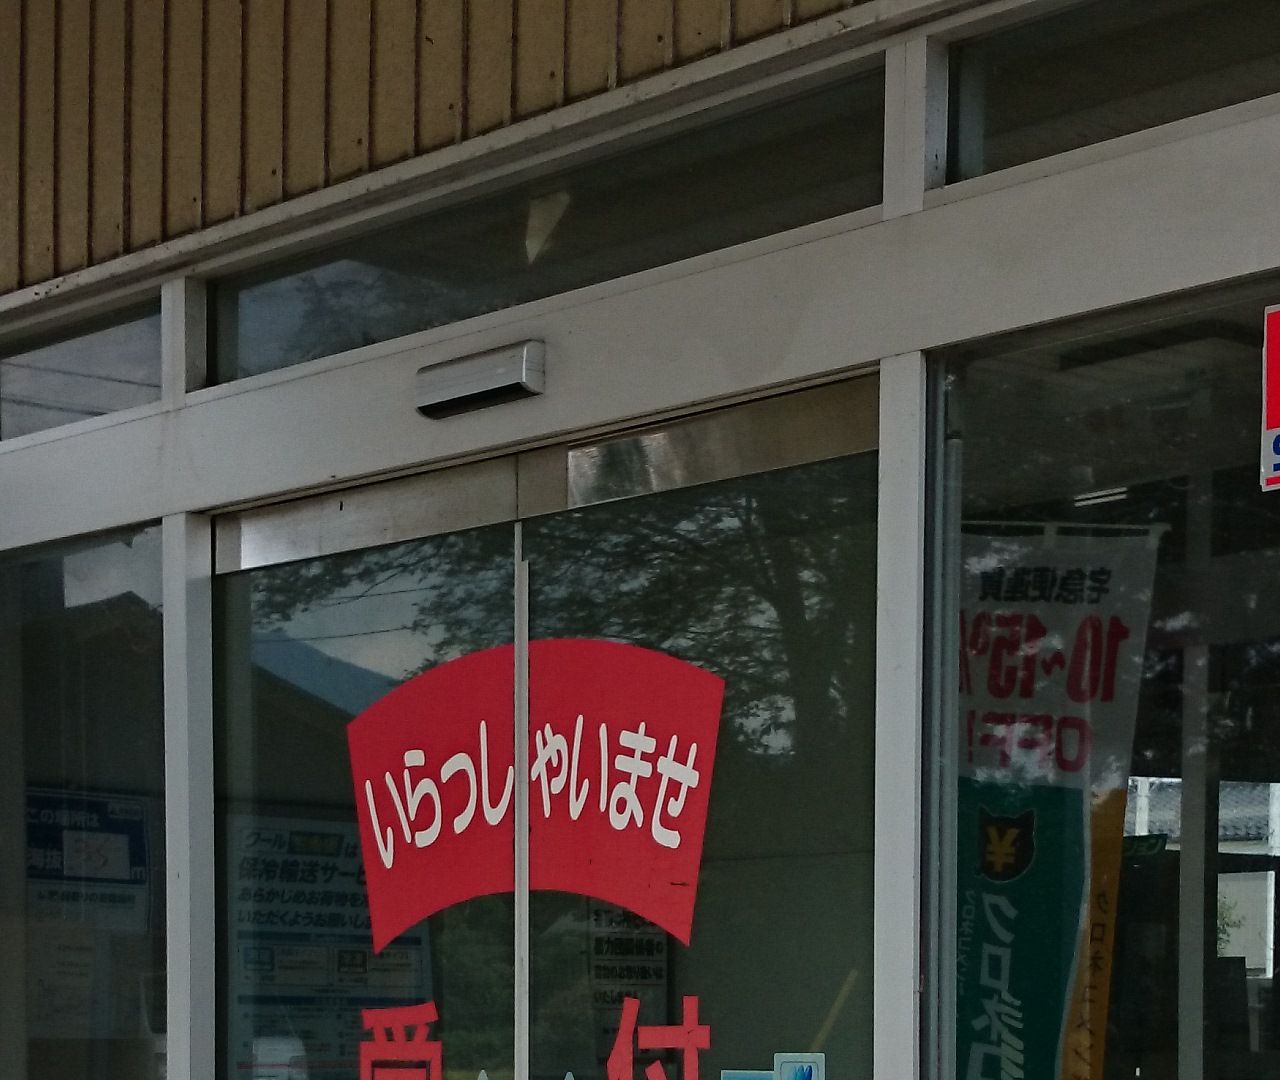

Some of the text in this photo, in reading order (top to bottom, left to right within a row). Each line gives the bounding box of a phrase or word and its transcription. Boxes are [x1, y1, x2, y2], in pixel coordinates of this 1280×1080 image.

[365, 714, 699, 869] いらっしゃいませ
[238, 888, 368, 907] あらかじめお荷物を
